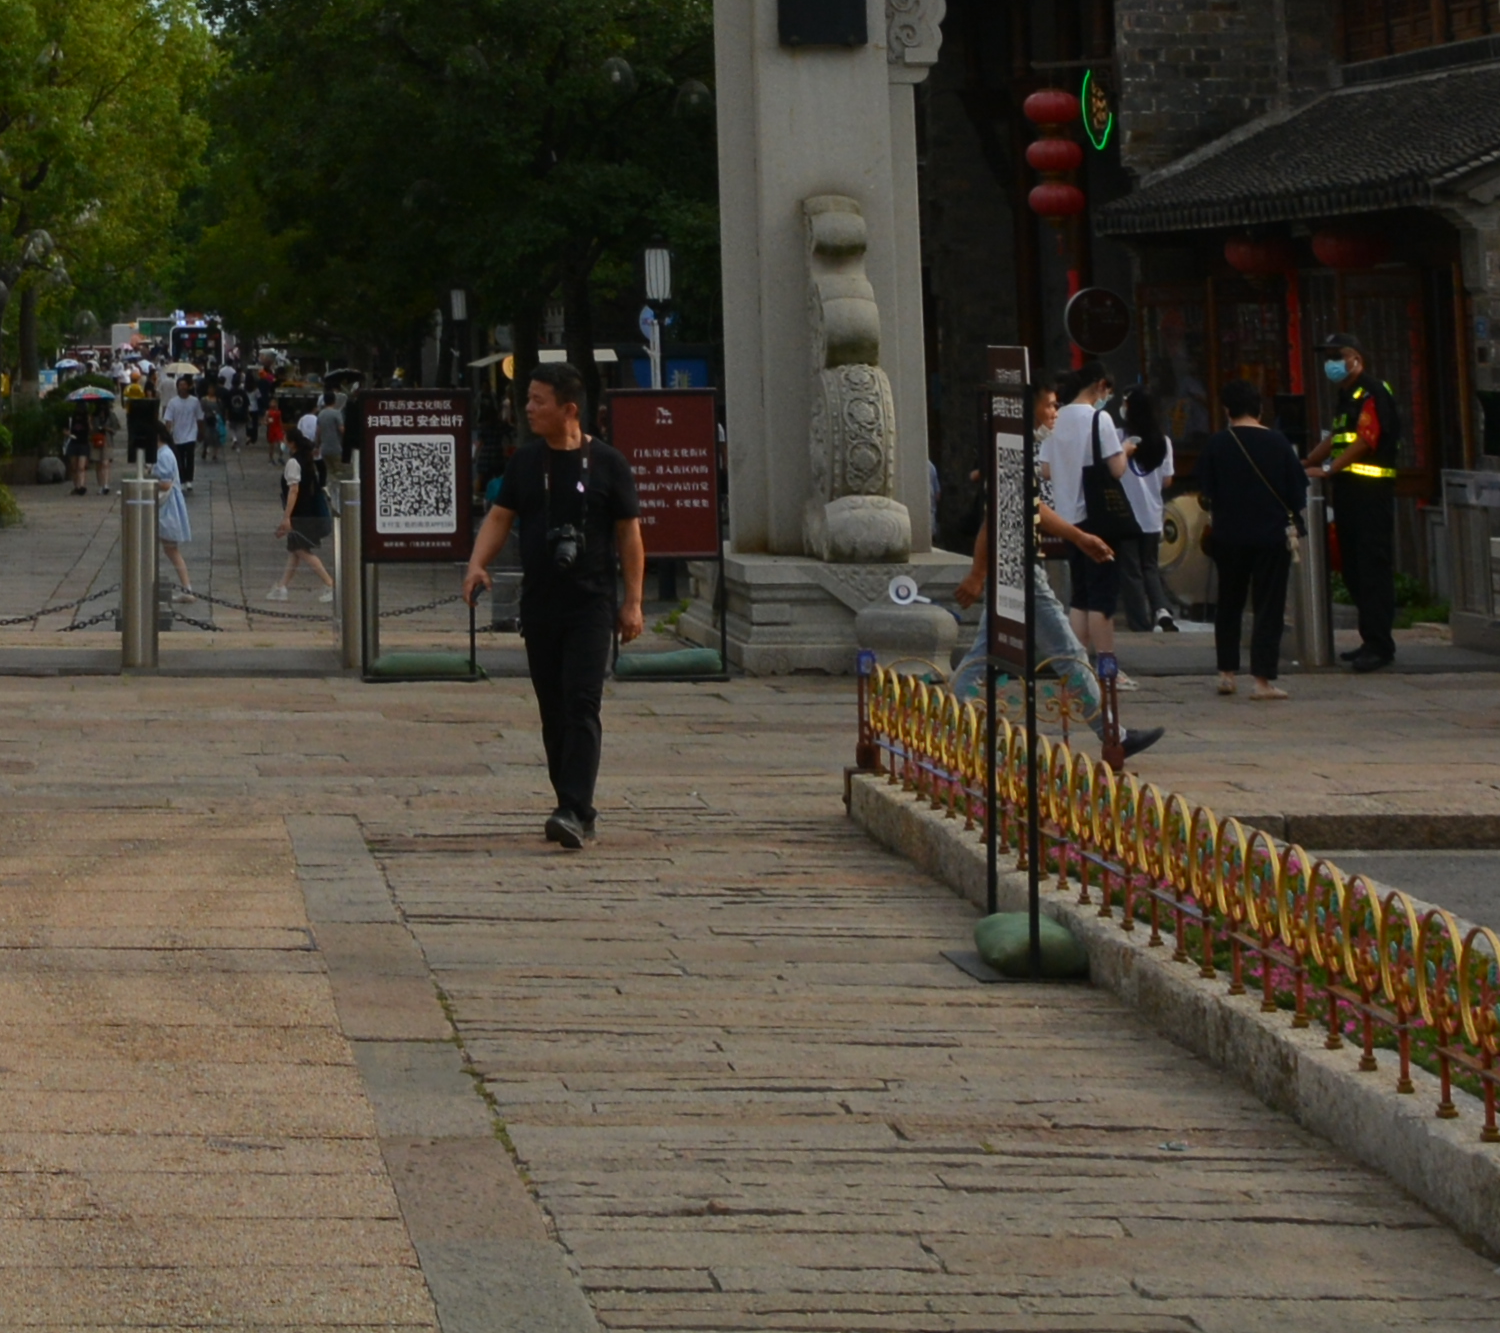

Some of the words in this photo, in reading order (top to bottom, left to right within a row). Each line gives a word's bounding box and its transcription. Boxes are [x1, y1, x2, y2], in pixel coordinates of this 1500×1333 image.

[378, 400, 452, 411] 门东历史文化街区
[367, 415, 414, 428] 扫码登记
[417, 414, 464, 428] 安全出行
[633, 448, 708, 458] 门东历史文化街区
[635, 482, 709, 492] 和商户室内请自觉
